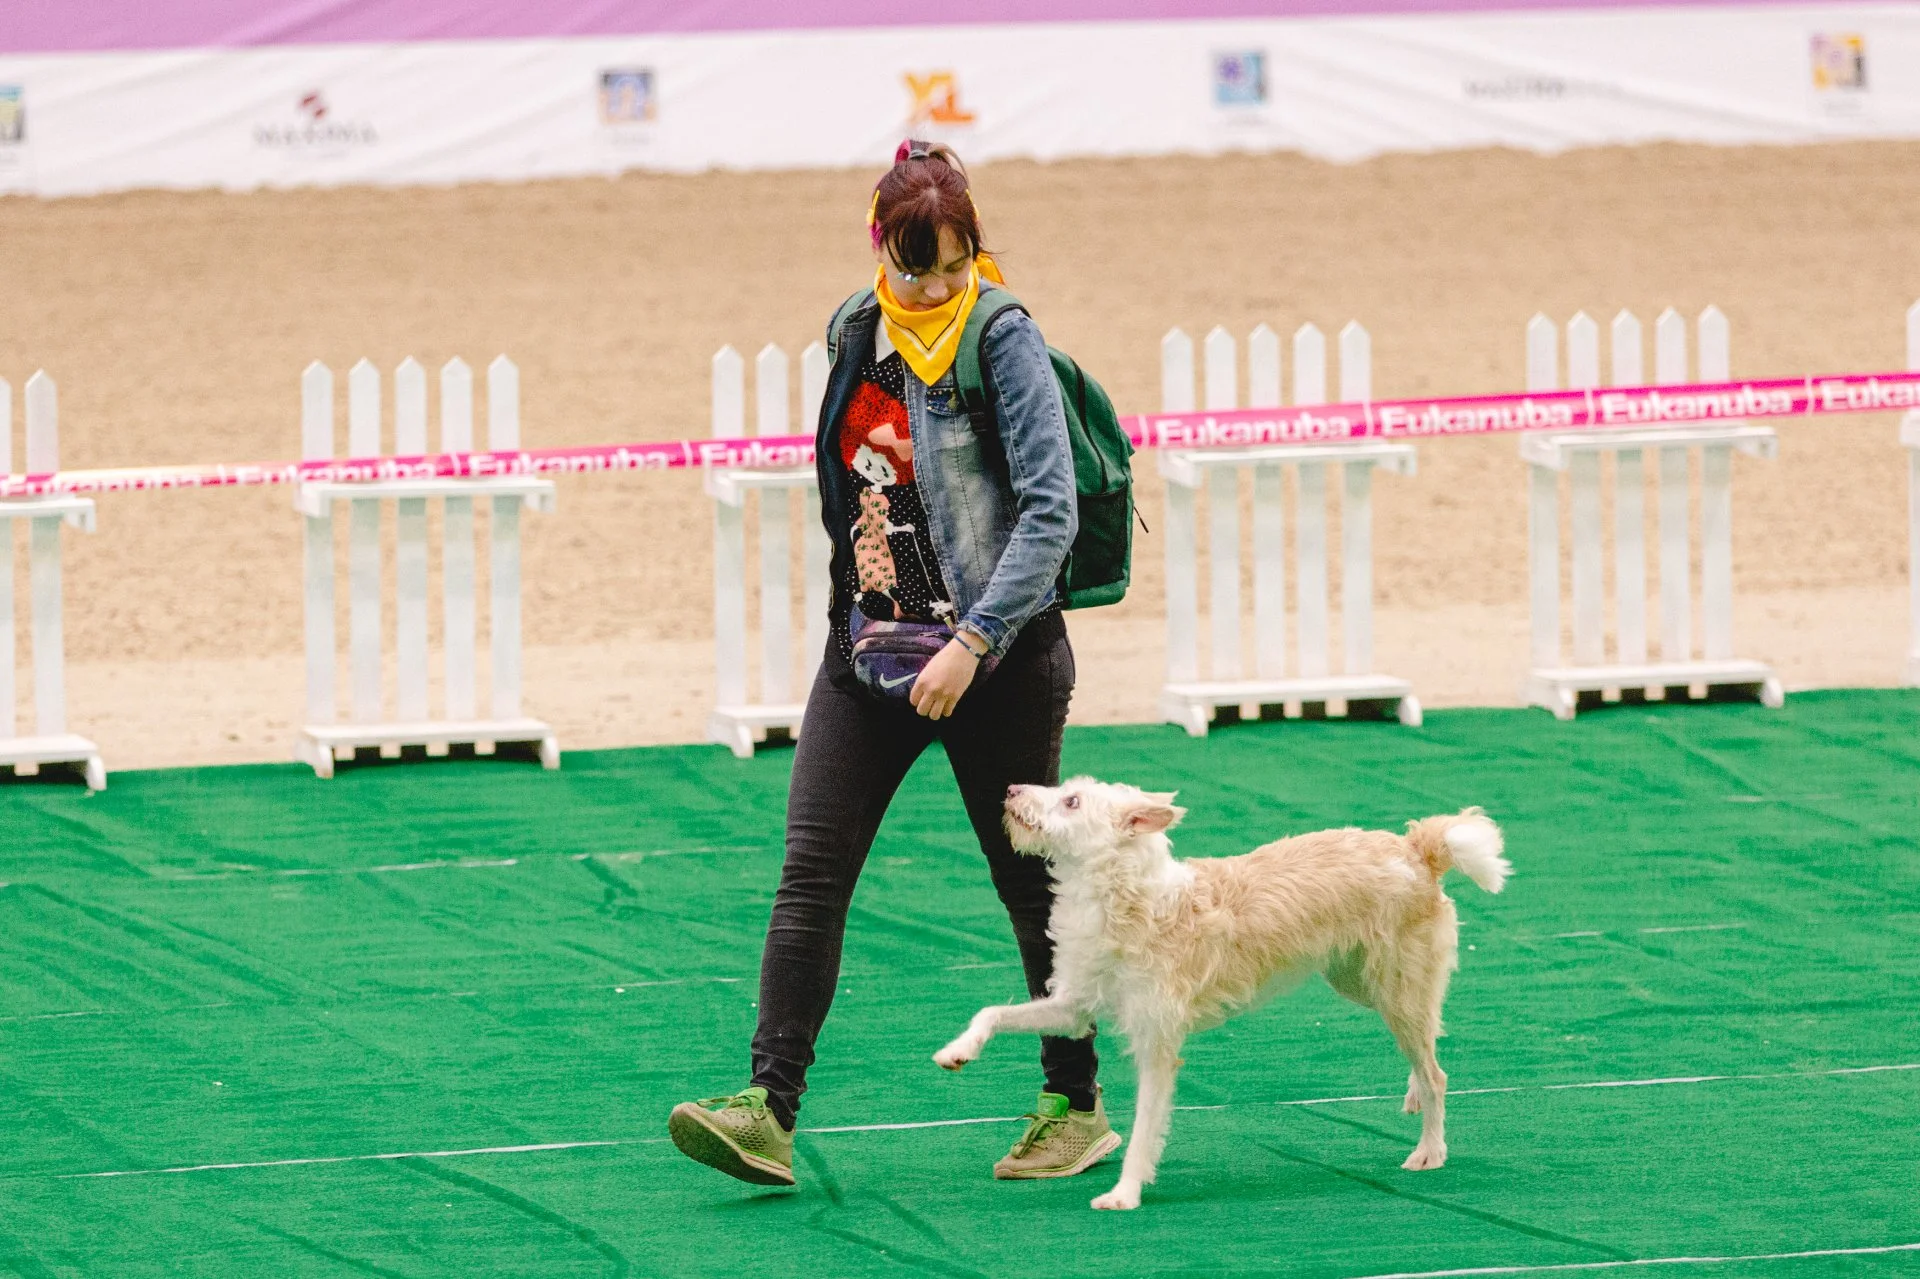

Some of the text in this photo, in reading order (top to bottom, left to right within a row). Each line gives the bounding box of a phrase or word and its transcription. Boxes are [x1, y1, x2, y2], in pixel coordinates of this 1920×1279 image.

[1155, 377, 1920, 445] Eukanuba Eukanuba Eukanuba Euka
[234, 459, 435, 486] Eukanuba
[468, 447, 667, 477] Eukanuba
